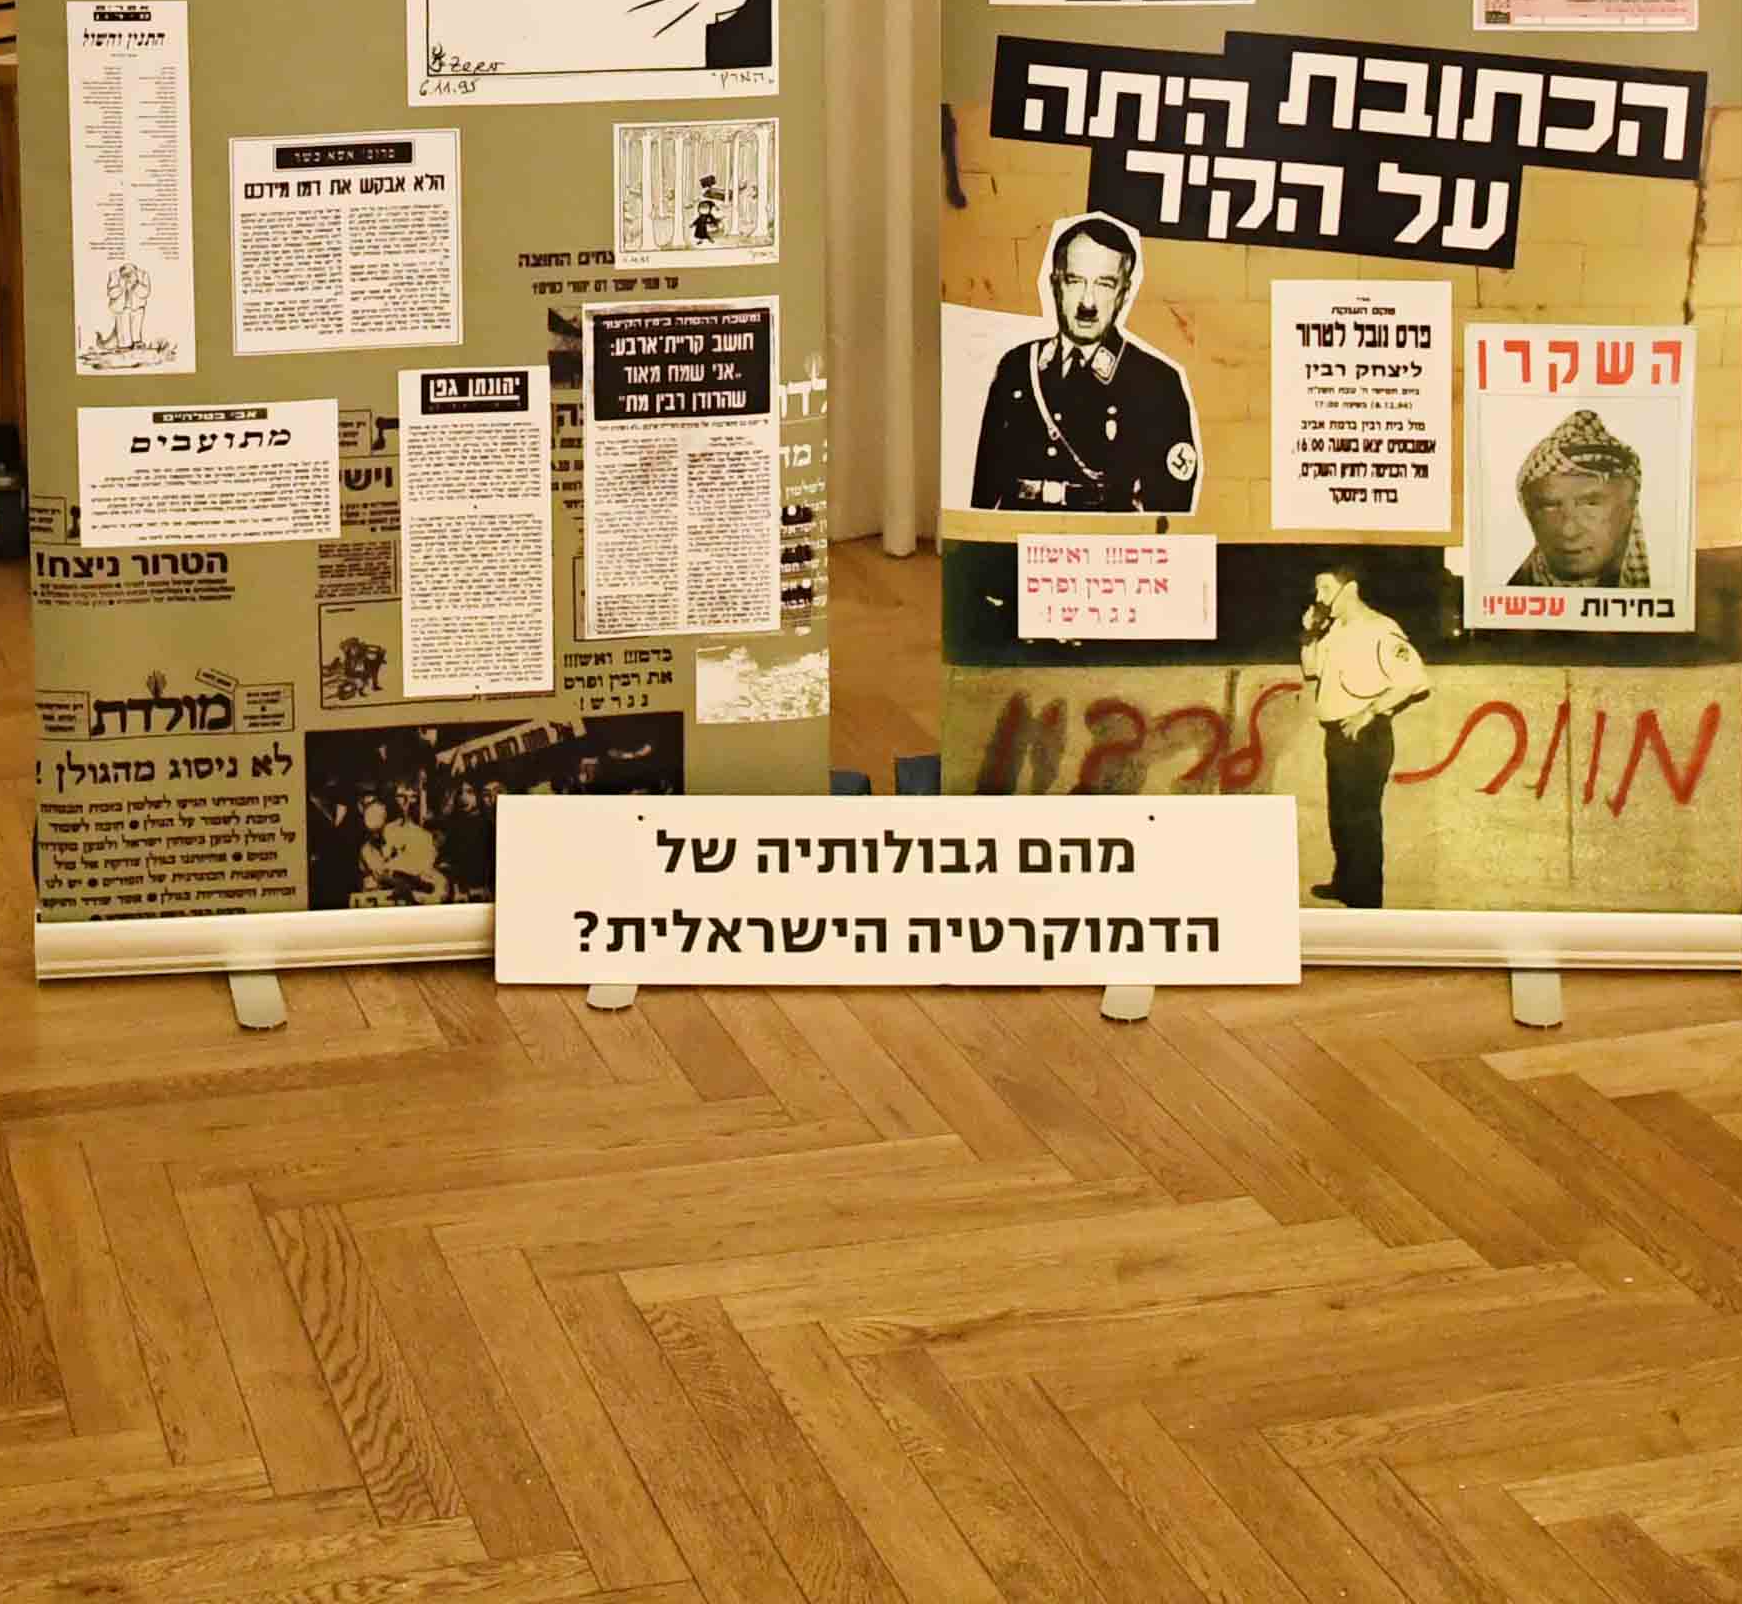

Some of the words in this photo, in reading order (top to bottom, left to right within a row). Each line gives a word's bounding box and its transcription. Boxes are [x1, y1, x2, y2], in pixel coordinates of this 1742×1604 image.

[1024, 62, 1250, 148] היתה
[1278, 52, 1689, 160] הכתובת
[330, 178, 351, 195] את
[1126, 150, 1346, 239] הקיר
[1378, 162, 1510, 252] על
[712, 333, 753, 352] חושב
[1397, 324, 1431, 349] פרס
[624, 367, 660, 384] מאוד
[667, 366, 704, 382] שמח
[1305, 363, 1346, 380] רבין
[1355, 361, 1423, 378] ליצחק
[1477, 339, 1682, 391] השקרן
[430, 379, 458, 399] גפן
[468, 377, 520, 398] יהונתן
[131, 428, 292, 454] מתועבים
[132, 552, 227, 576] הטרור
[1581, 598, 1675, 617] בחירות
[90, 693, 232, 736] מולדת
[56, 750, 155, 793] מהגולן
[169, 755, 237, 781] ניסוג
[251, 742, 292, 777] לא
[658, 830, 735, 874] של
[758, 830, 997, 876] גבולותיה
[1018, 832, 1135, 874] מהם
[573, 911, 887, 953] הישראלית?
[909, 914, 1220, 963] הדמוקרטיה
